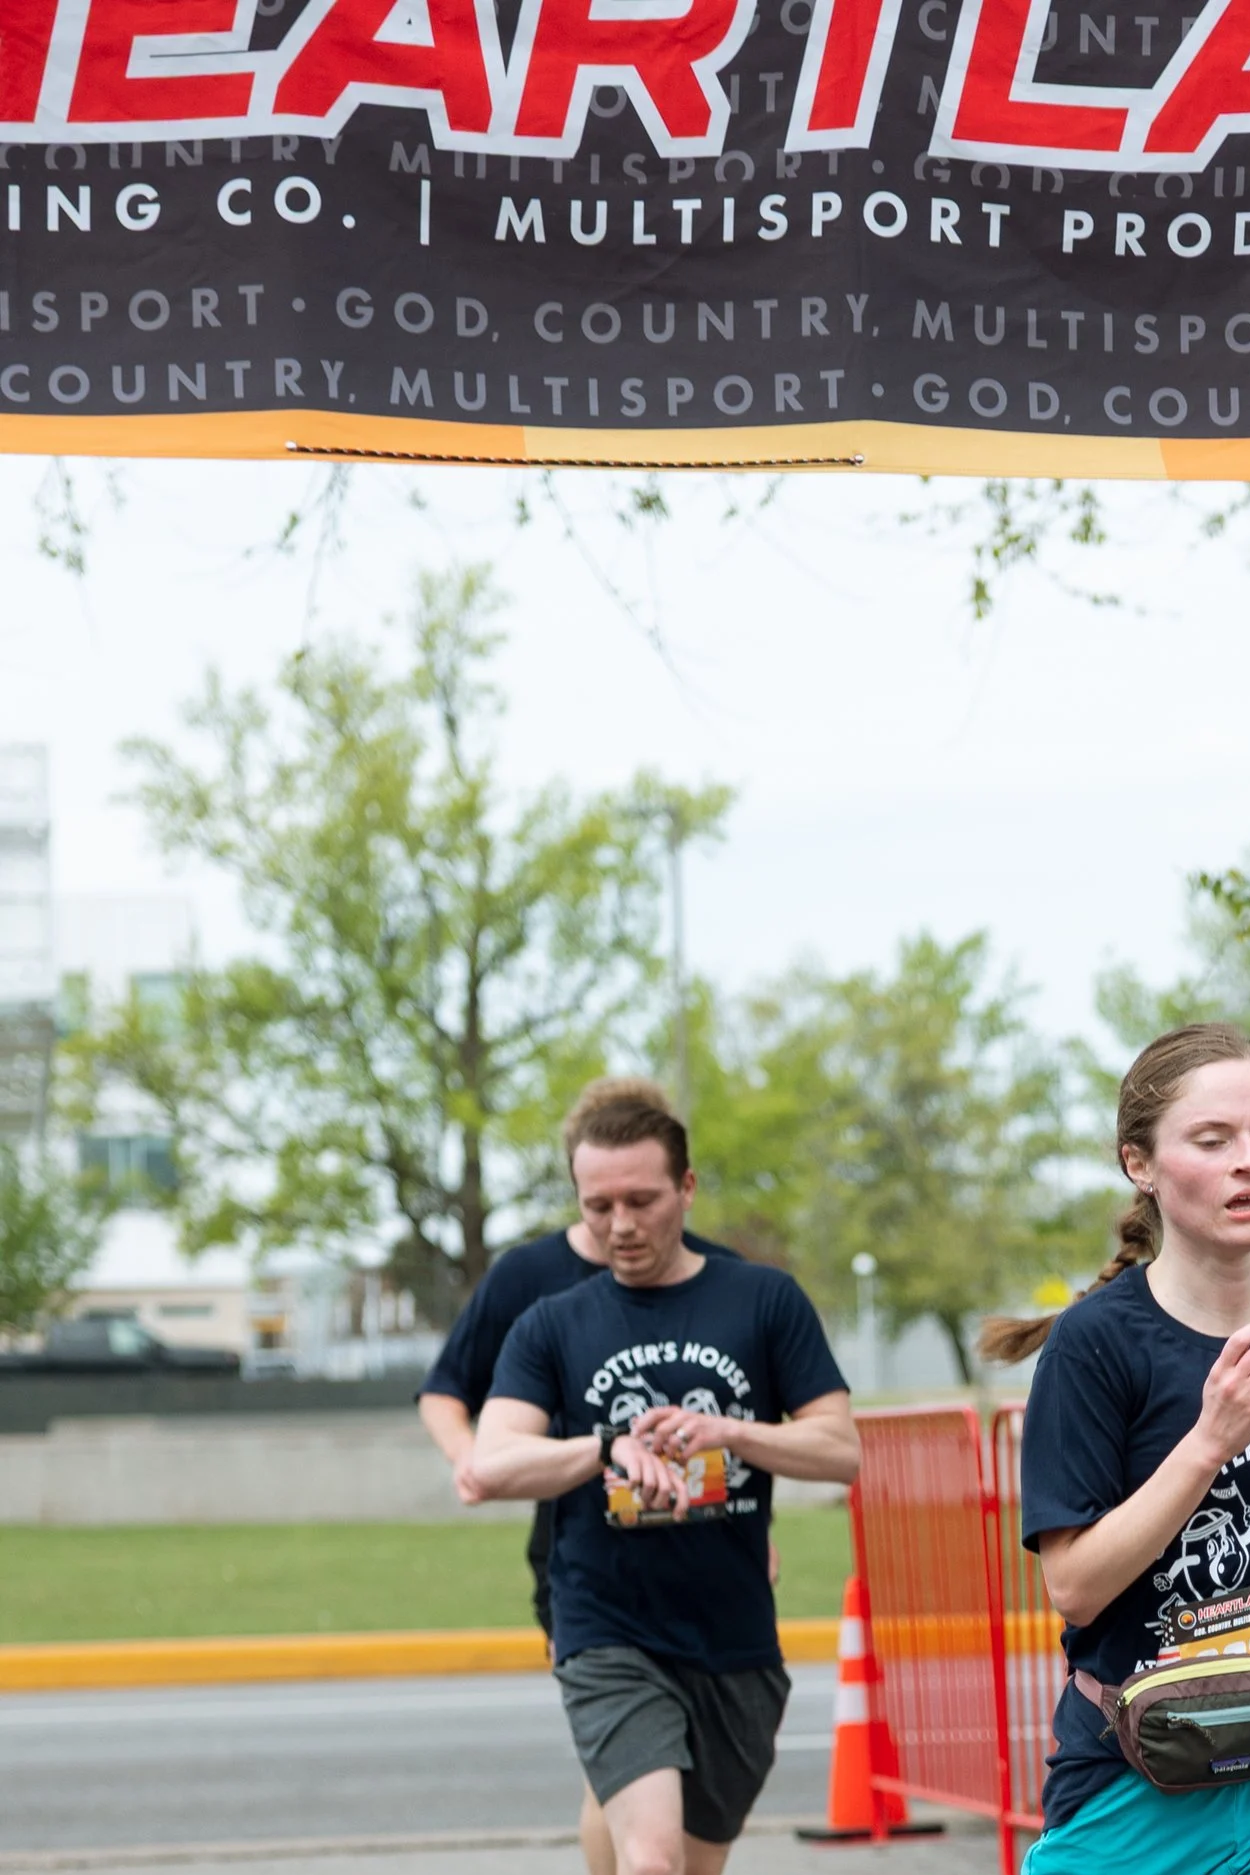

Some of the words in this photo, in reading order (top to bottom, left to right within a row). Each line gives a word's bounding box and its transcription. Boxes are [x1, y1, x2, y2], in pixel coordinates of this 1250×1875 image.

[217, 176, 356, 230] CO.
[495, 191, 1010, 248] MULTISPORT
[336, 287, 499, 343] GOD,
[534, 294, 879, 344] COUNTRY,
[0, 358, 356, 404] COUNTRY,
[389, 366, 845, 418] MULTISPORT
[912, 372, 1071, 425] GOD,
[584, 1341, 678, 1407] POTTER'S
[682, 1341, 752, 1399] HOUSE
